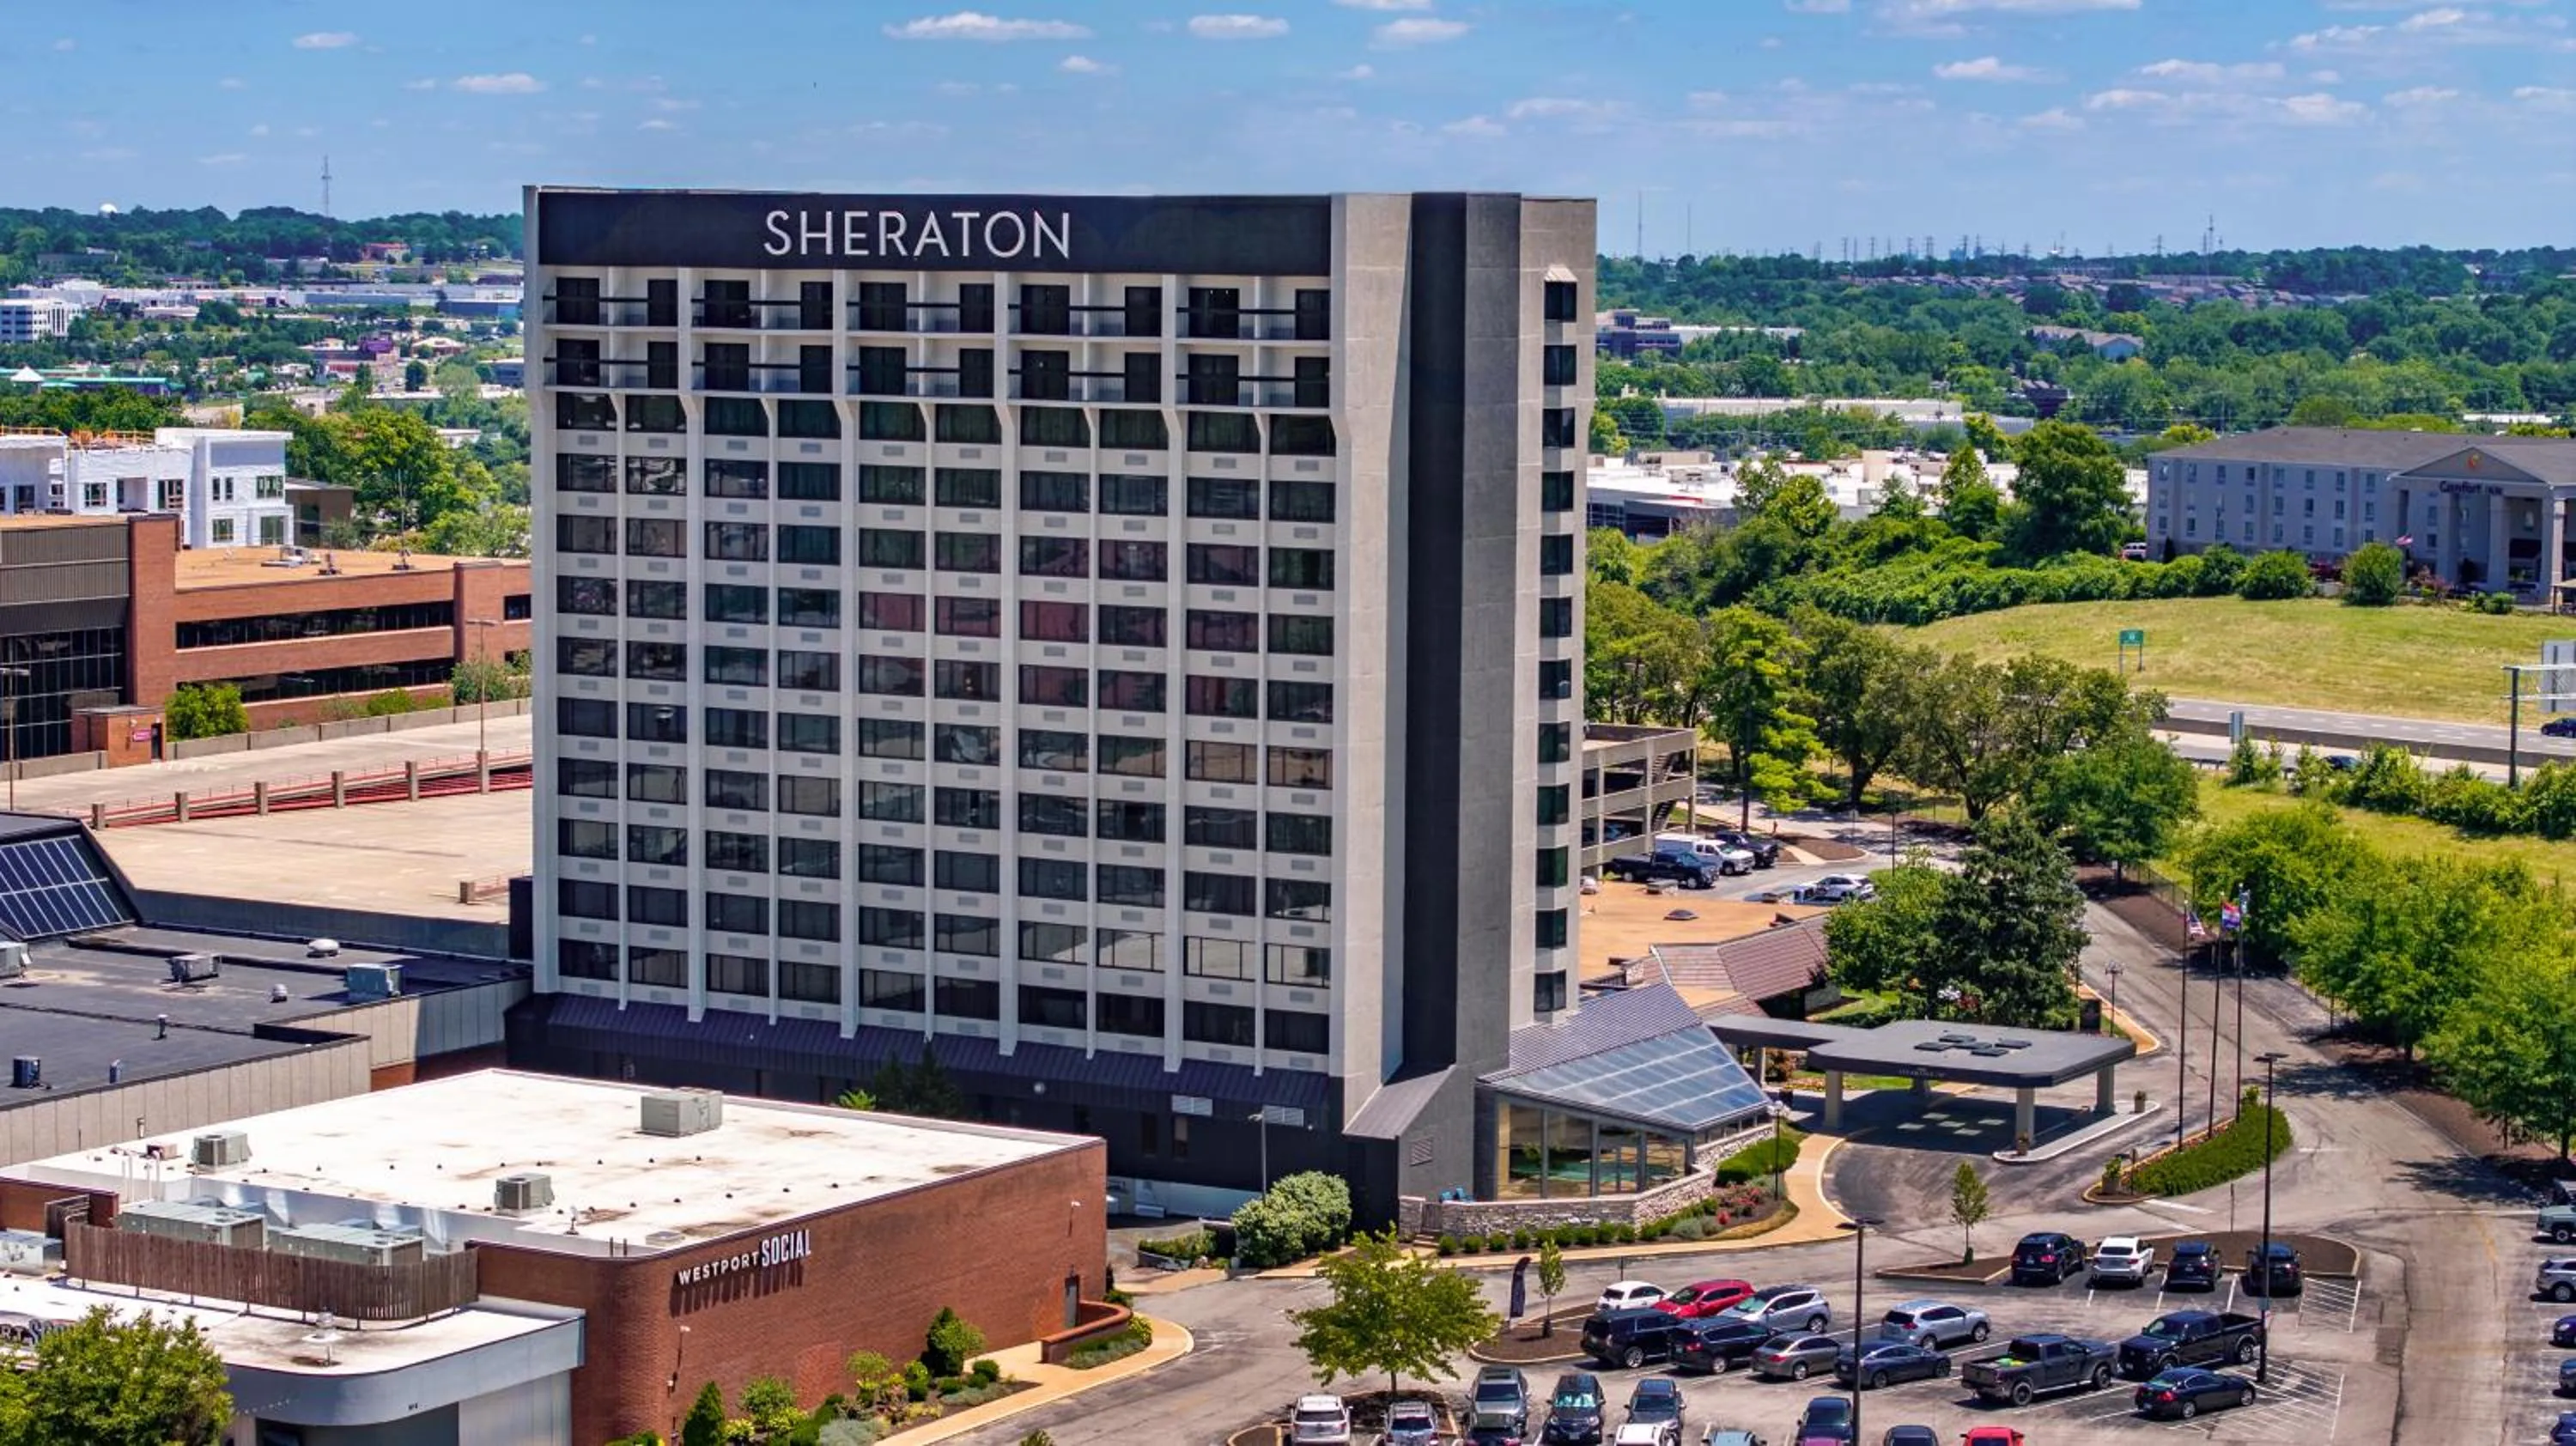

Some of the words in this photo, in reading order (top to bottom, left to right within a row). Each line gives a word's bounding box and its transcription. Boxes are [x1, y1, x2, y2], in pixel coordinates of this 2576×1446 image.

[762, 210, 1070, 258] SHERATON
[2439, 480, 2481, 495] Comfort
[678, 1251, 759, 1285] WESTPORT
[762, 1229, 811, 1267] SOCIAL
